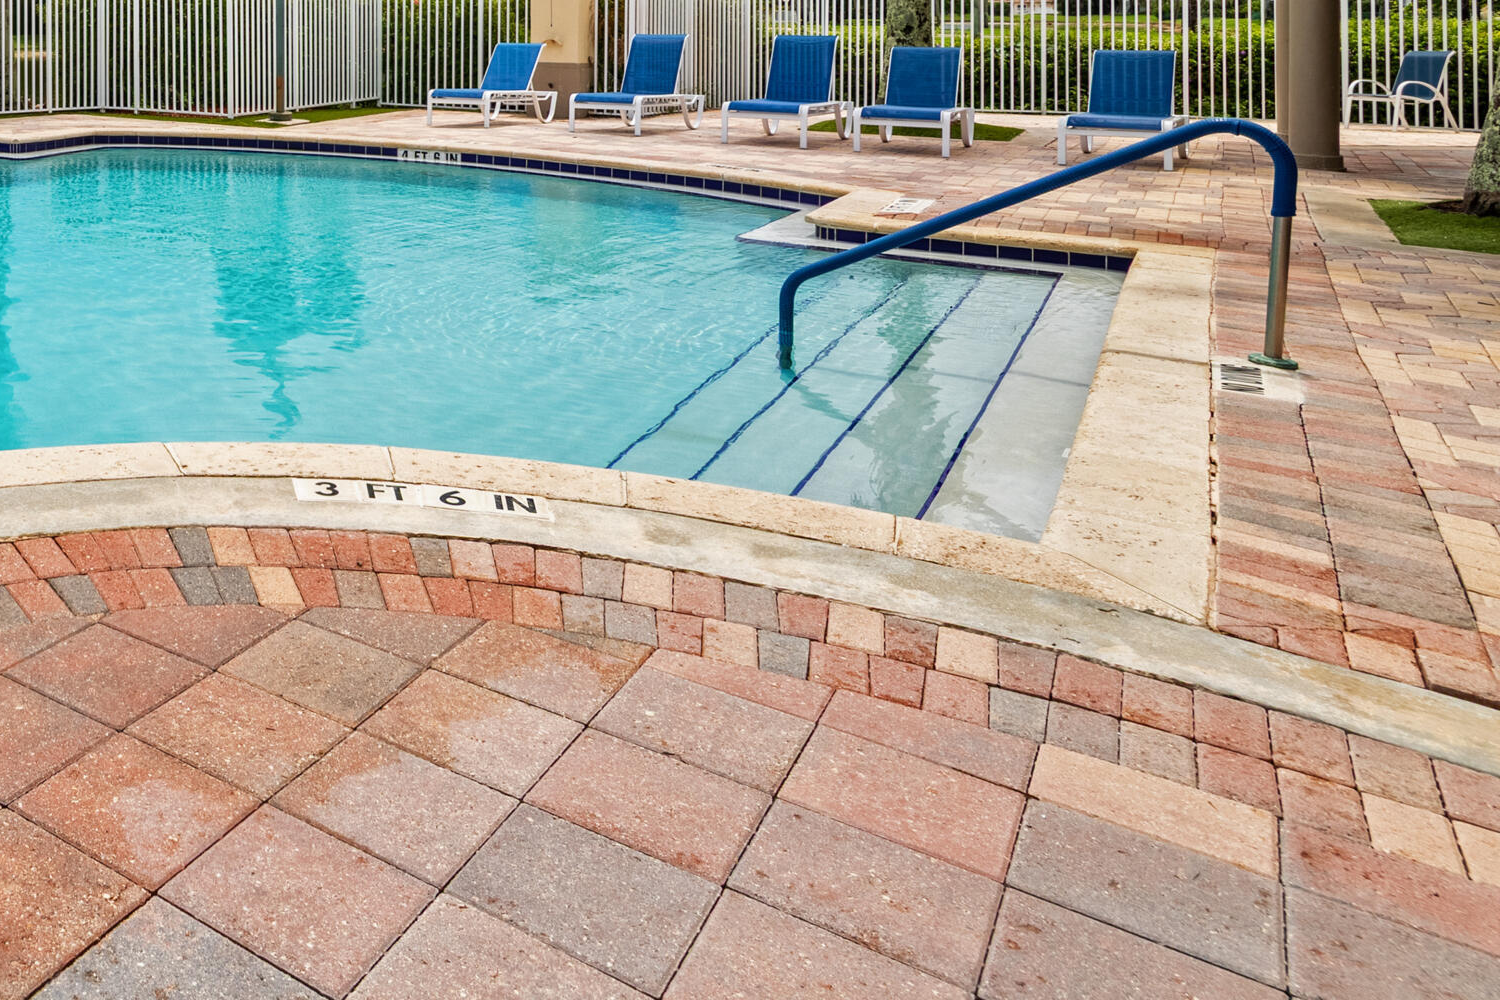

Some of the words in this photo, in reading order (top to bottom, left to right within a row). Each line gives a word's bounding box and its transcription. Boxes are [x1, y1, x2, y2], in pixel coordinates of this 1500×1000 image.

[414, 151, 428, 159] FT
[446, 153, 458, 161] IN
[315, 482, 340, 496] 3
[366, 483, 406, 501] FT
[439, 490, 466, 506] 6
[494, 494, 538, 514] IN
